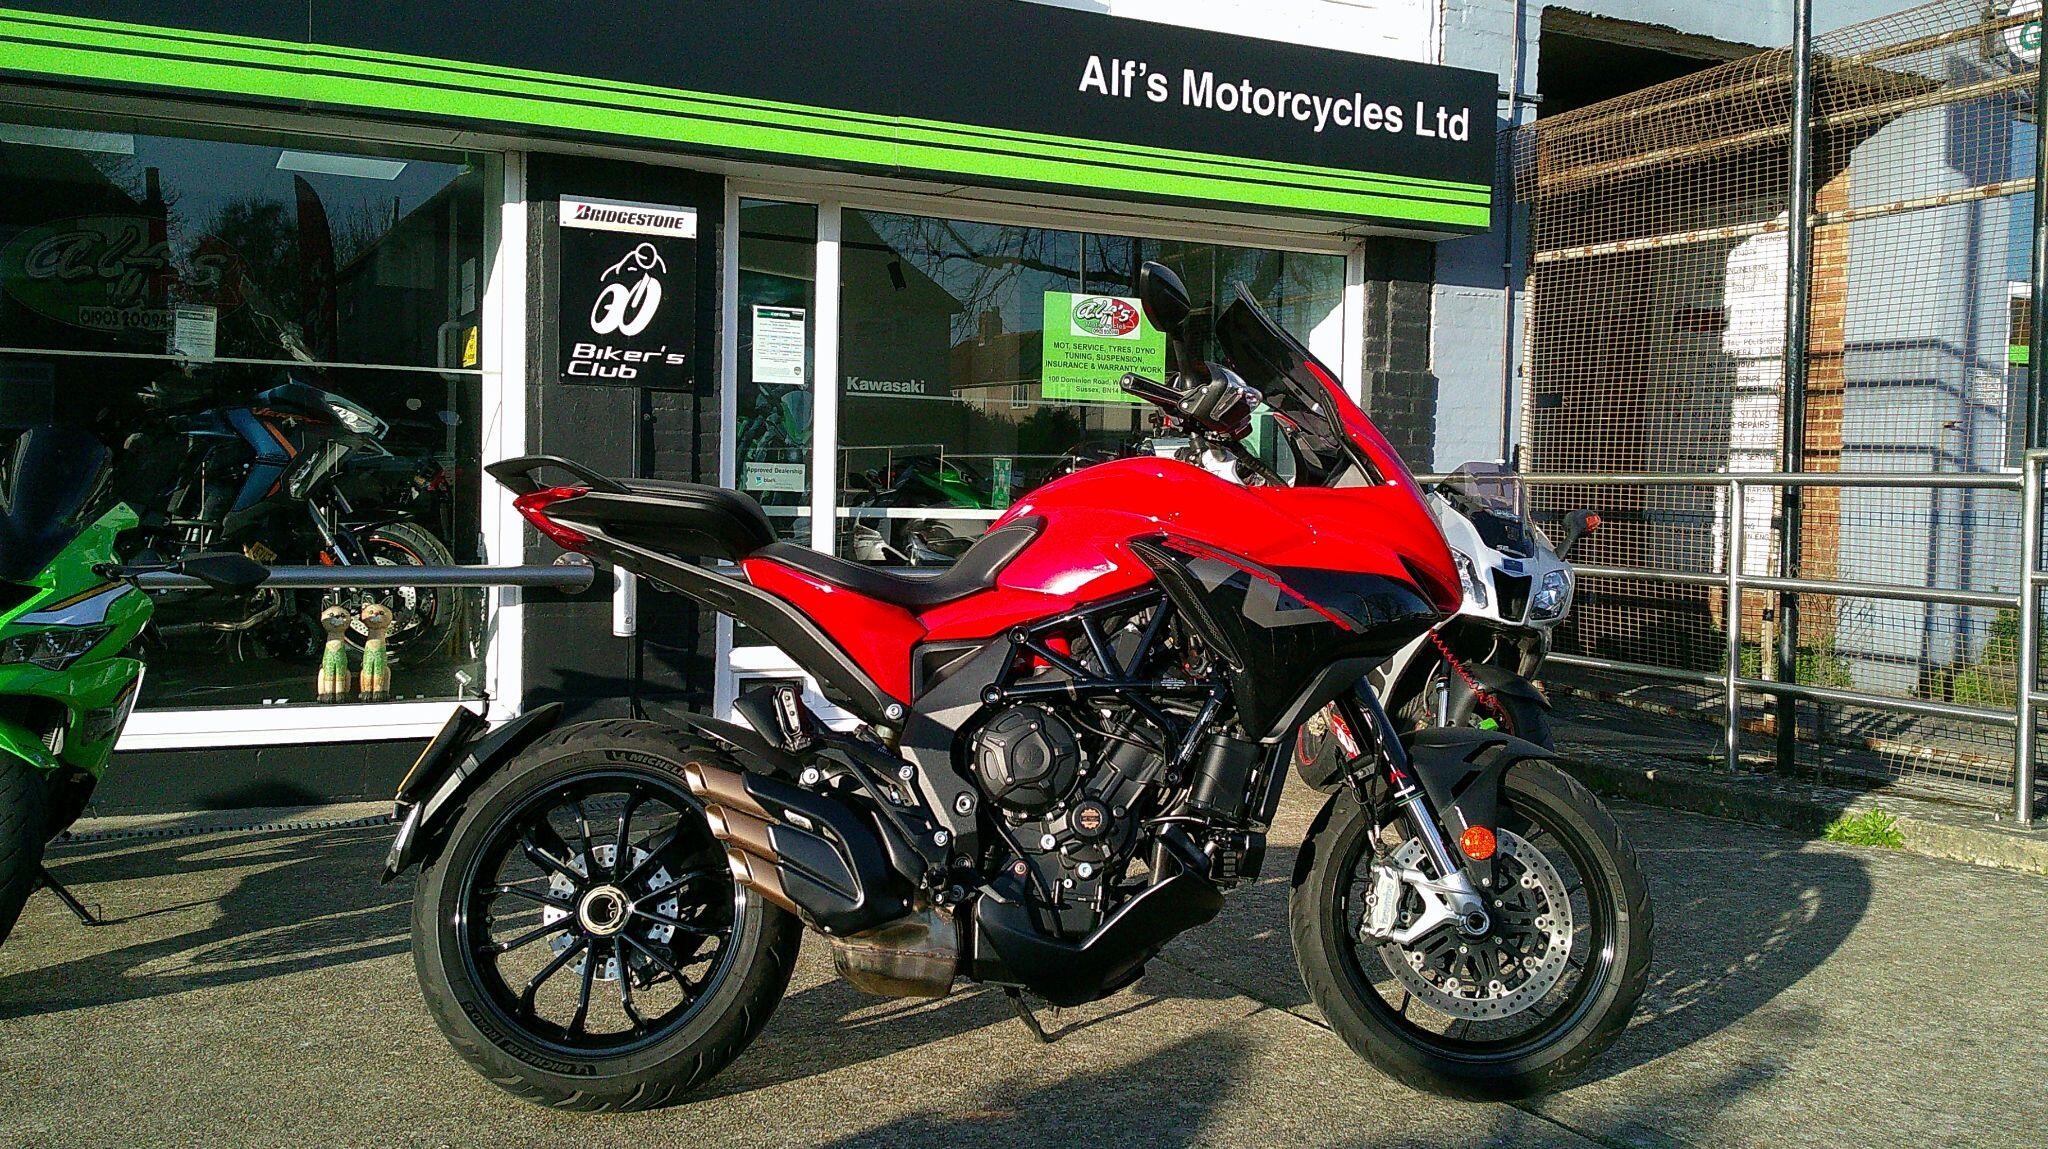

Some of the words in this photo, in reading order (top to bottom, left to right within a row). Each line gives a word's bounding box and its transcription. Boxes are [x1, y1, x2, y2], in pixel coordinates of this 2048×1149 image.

[1078, 54, 1169, 103] Alf's
[1182, 68, 1404, 134] Motorcycles
[1415, 100, 1470, 142] Ltd
[574, 204, 684, 230] BRIDGESTONE
[572, 342, 686, 365] Biker's
[1053, 341, 1071, 350] MOT,
[1135, 346, 1156, 355] DYNO
[1065, 351, 1094, 361] TUNING,
[1096, 353, 1144, 364] SUSPENSION,
[567, 360, 638, 379] Club
[1045, 360, 1088, 370] INSURANCE
[1097, 363, 1138, 373] WARRANTY
[1140, 365, 1163, 374] WORK
[846, 376, 925, 394] Kawasaki
[1060, 376, 1092, 384] Dominion
[1076, 385, 1100, 394] Sussex,
[1737, 420, 1770, 430] REPAIRS
[747, 466, 773, 474] Approved
[774, 467, 803, 475] Dealership
[506, 1040, 573, 1075] MICHELIN
